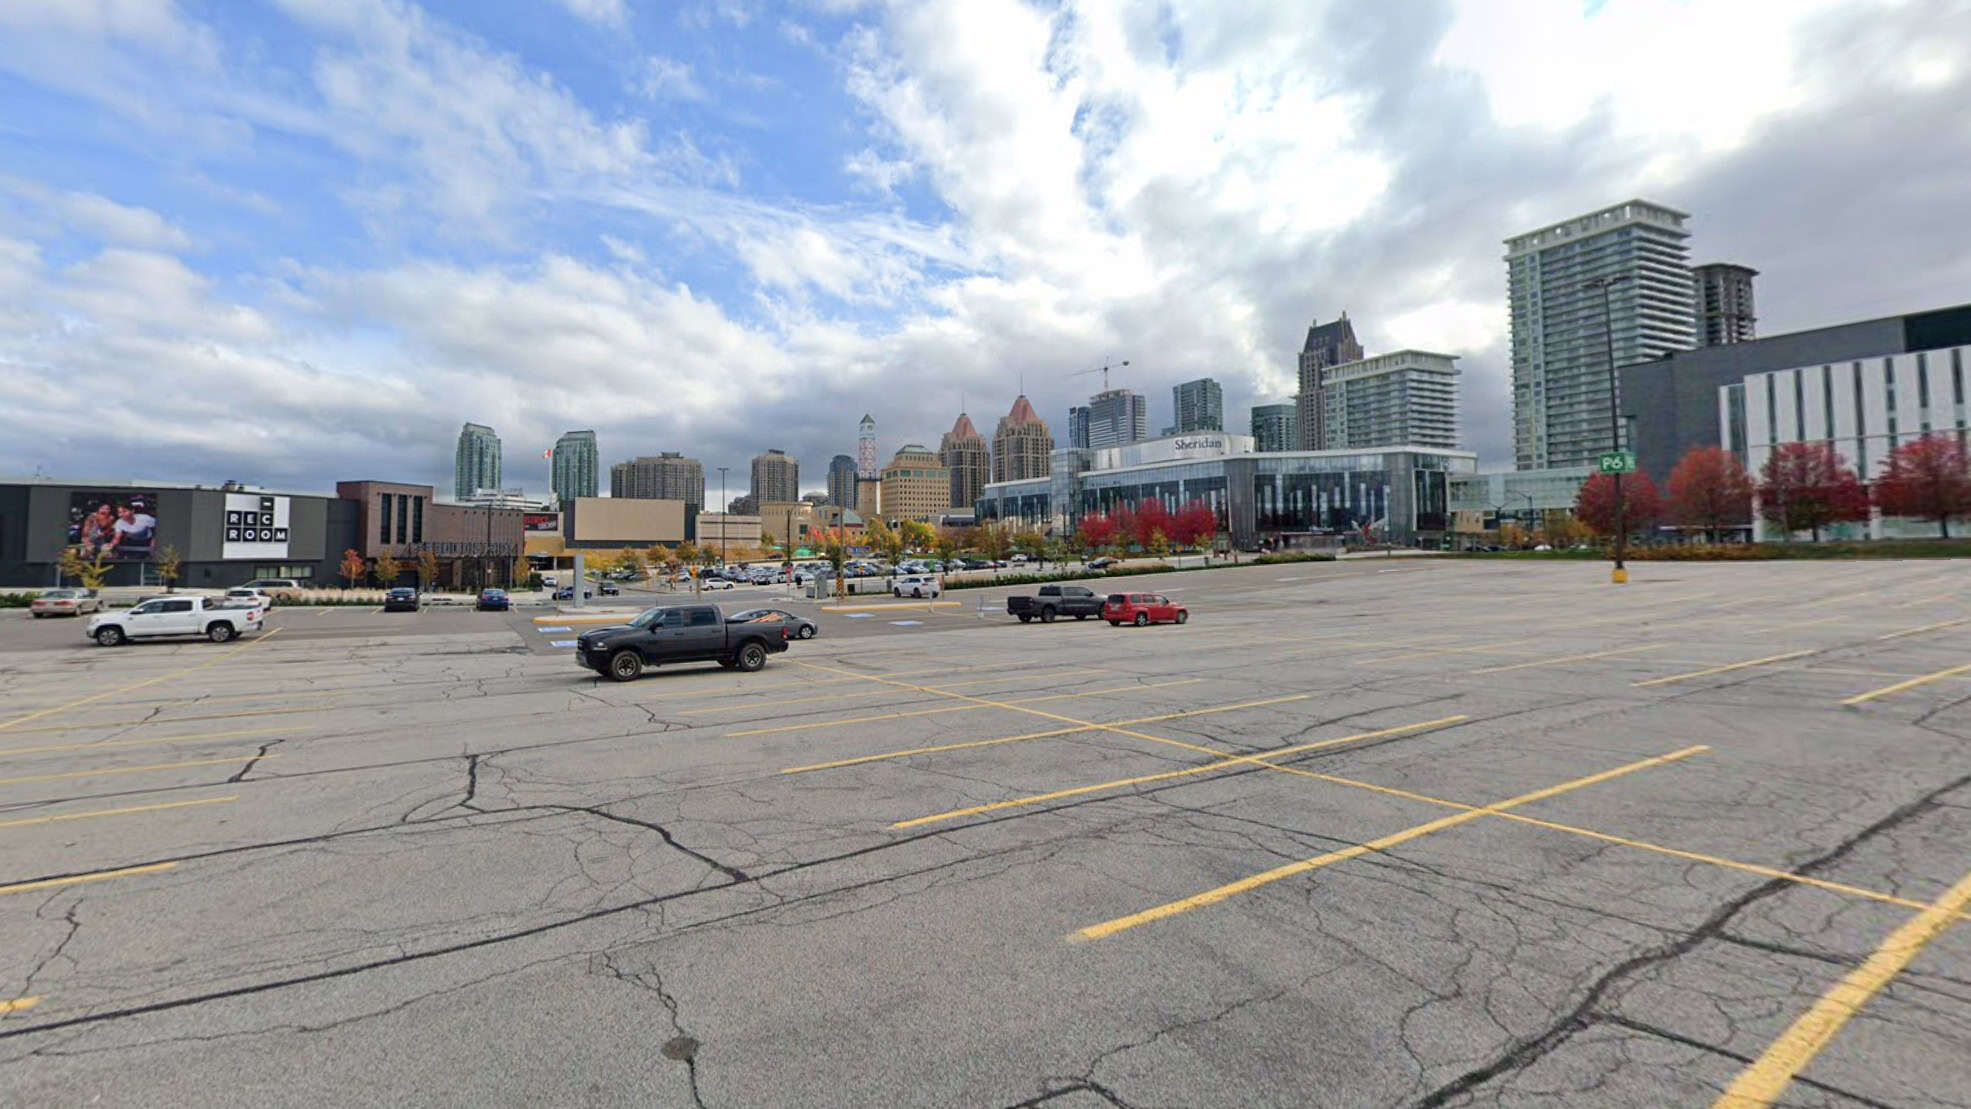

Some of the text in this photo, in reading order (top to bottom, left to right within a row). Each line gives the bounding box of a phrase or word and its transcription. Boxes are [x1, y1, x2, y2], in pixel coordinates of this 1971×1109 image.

[1175, 437, 1222, 450] Sheridan
[1603, 456, 1624, 470] P6
[229, 513, 271, 524] REC
[228, 529, 286, 540] ROOM
